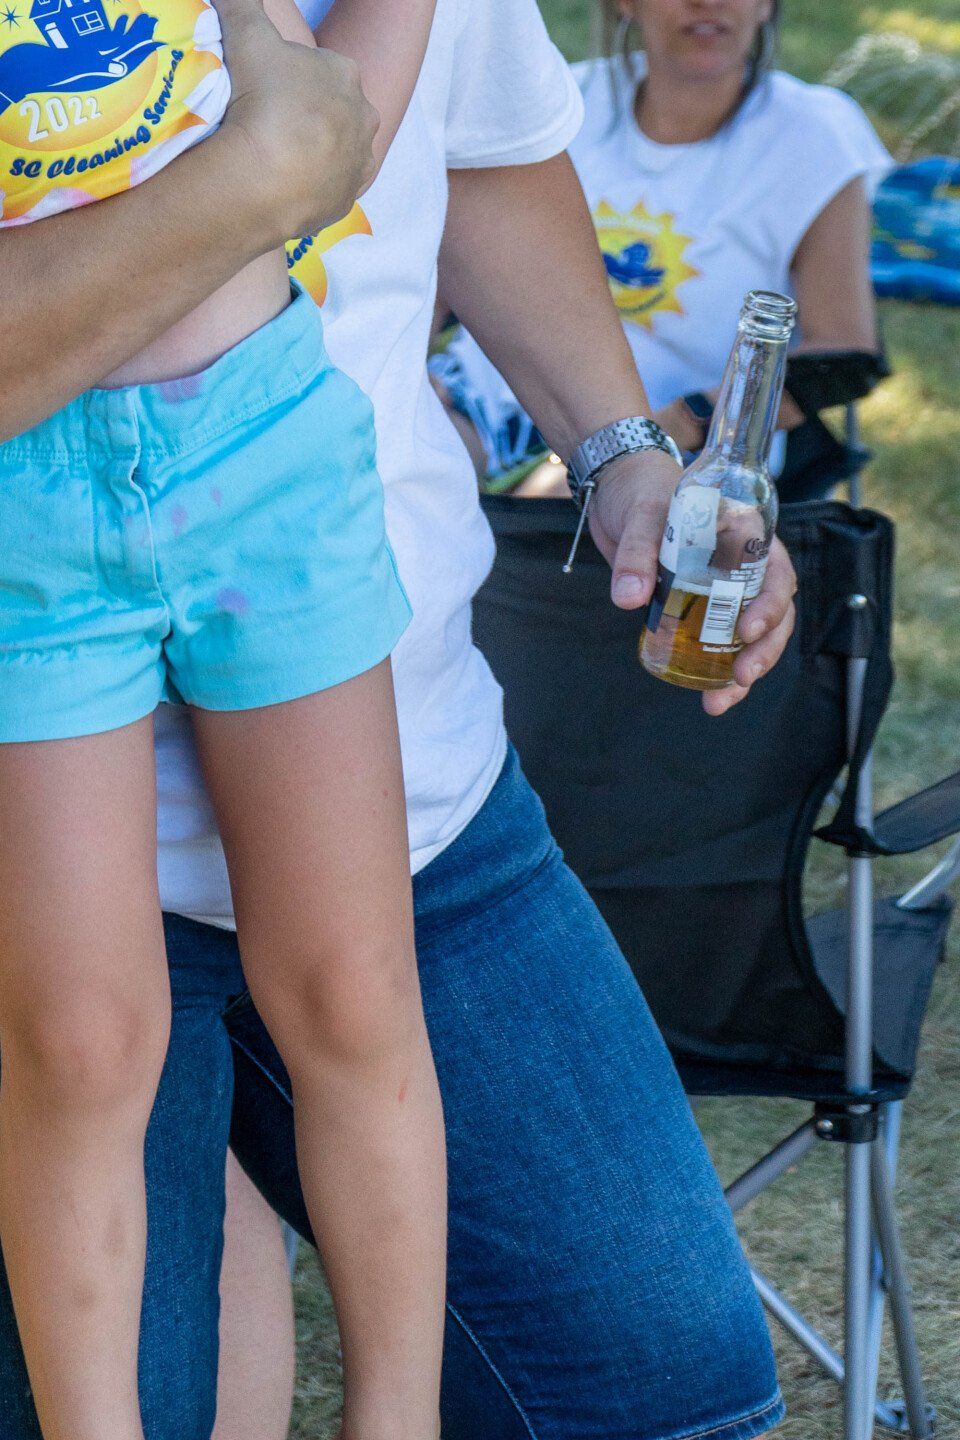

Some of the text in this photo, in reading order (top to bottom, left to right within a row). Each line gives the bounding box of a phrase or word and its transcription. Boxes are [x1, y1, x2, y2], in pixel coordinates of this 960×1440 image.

[9, 48, 184, 179] SC Cleaning Services
[19, 95, 102, 143] 2022
